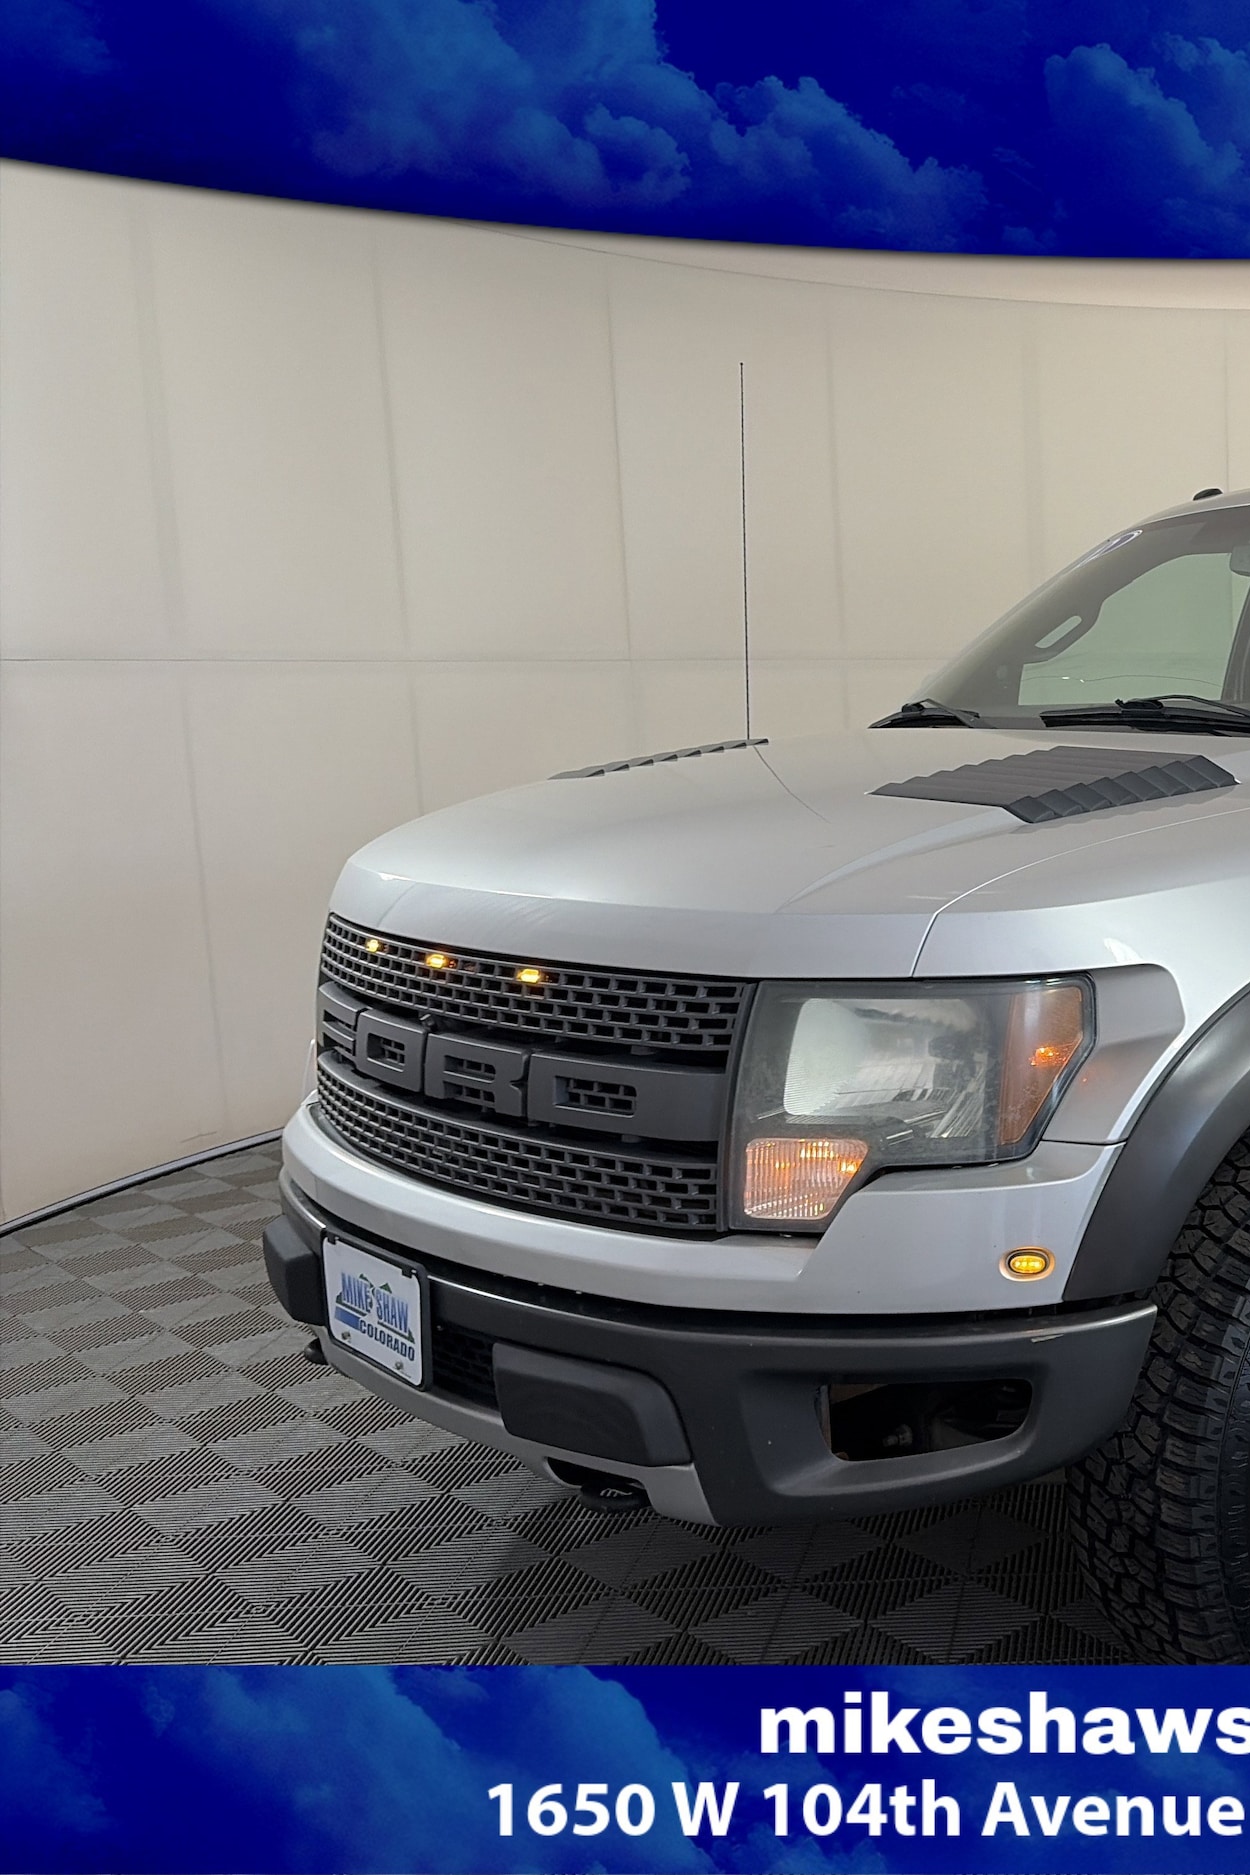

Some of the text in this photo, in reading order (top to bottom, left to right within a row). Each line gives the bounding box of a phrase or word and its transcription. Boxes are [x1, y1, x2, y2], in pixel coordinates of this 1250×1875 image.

[316, 980, 728, 1142] FORD
[341, 1272, 409, 1334] MIKE SHAW
[359, 1319, 415, 1361] COLORADO
